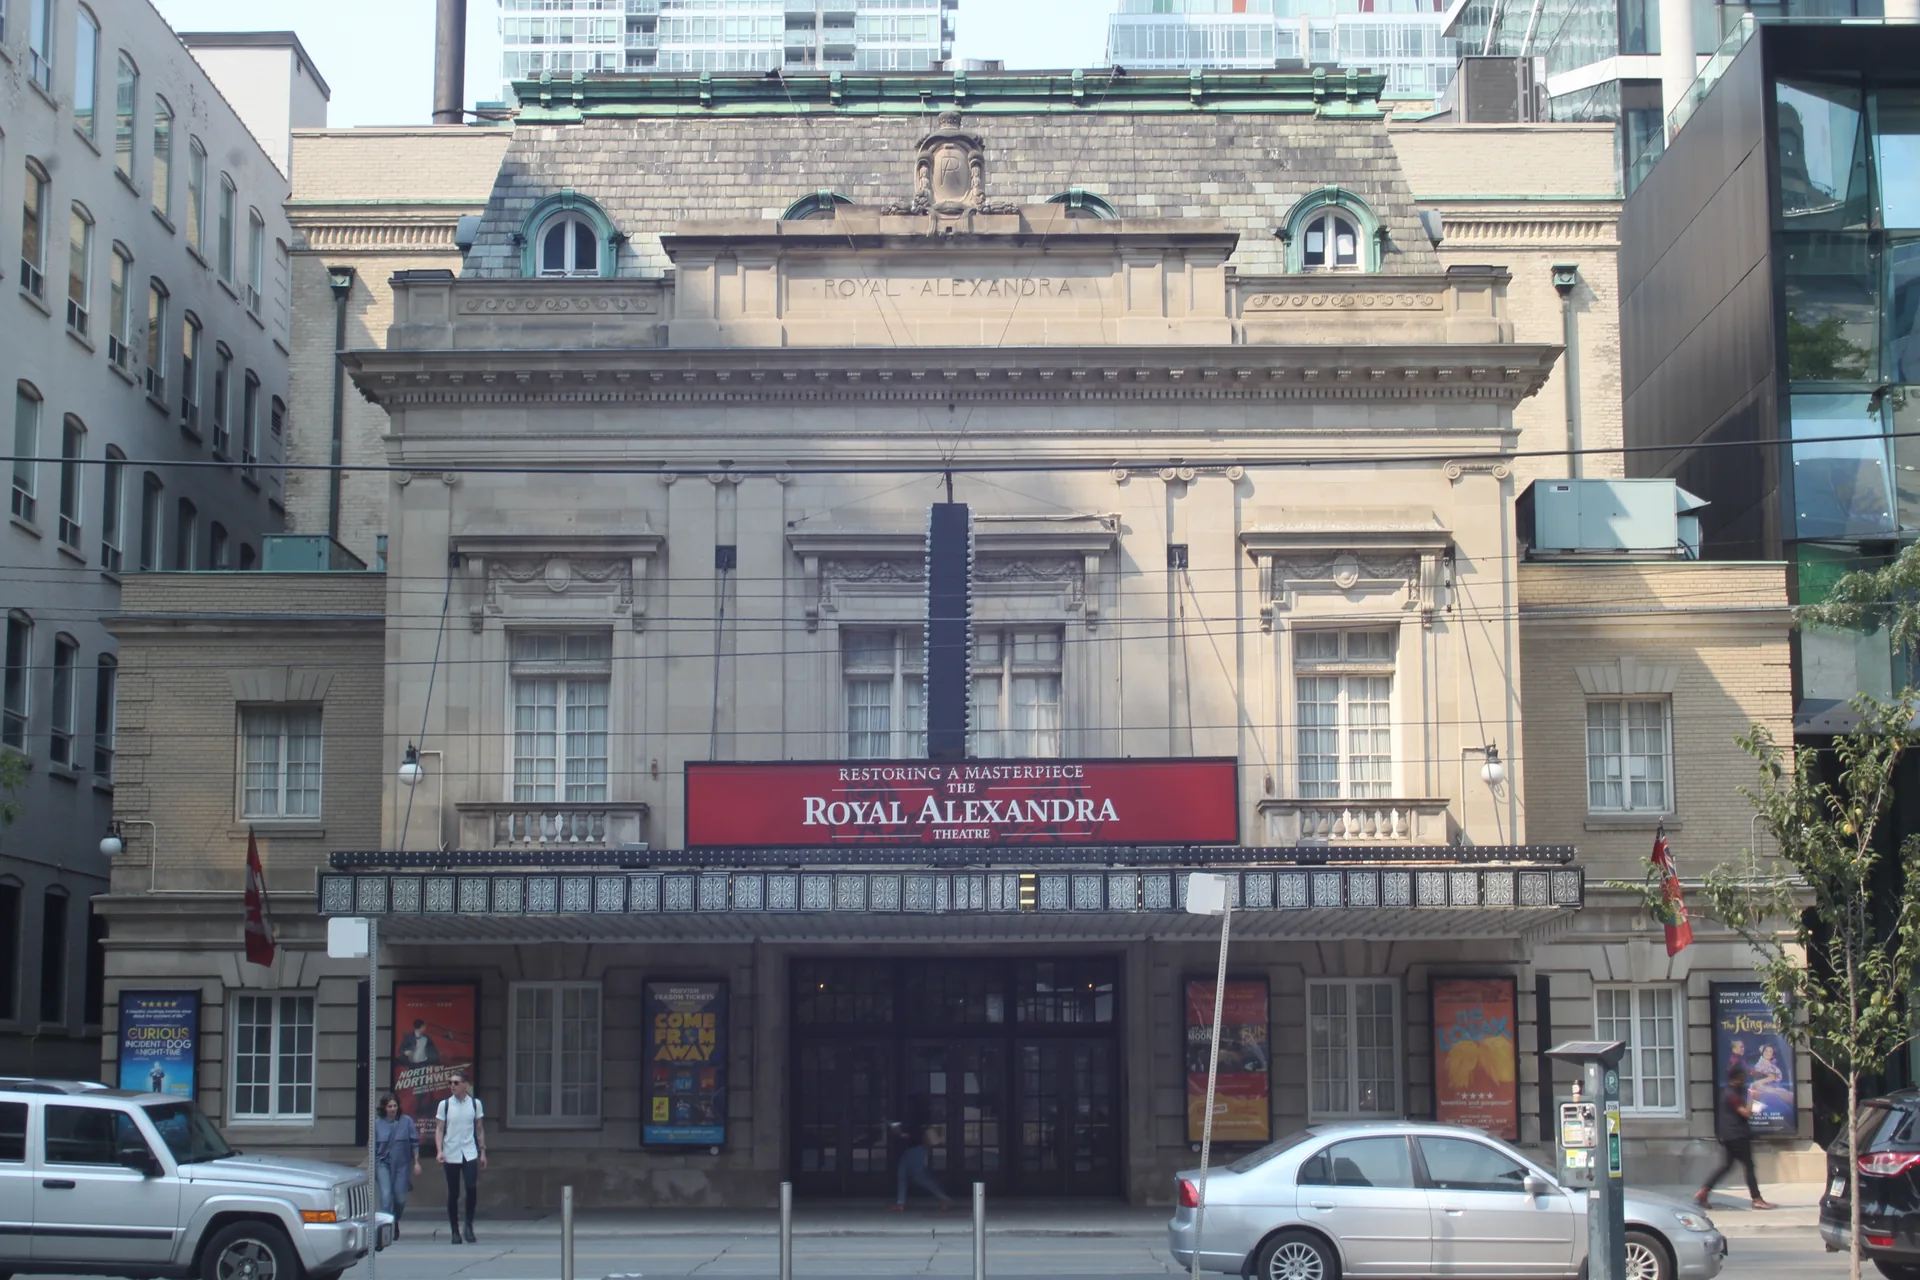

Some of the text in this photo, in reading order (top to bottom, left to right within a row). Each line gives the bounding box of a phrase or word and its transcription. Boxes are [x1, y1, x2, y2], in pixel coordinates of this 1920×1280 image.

[824, 278, 1073, 298] ROYAL ALEXANDRA
[838, 765, 1084, 781] RESTORING A MASTERPIECE
[947, 783, 976, 794] THE
[802, 795, 1120, 826] ROYAL ALEXANDRA
[932, 828, 991, 840] THEATRE
[654, 1012, 716, 1028] COME
[1454, 1006, 1484, 1024] THE
[1732, 1015, 1764, 1035] King
[127, 1027, 190, 1040] CURIOUS
[1437, 1015, 1513, 1052] LORAX
[125, 1040, 161, 1048] INCIDENT
[166, 1039, 192, 1049] DOG
[654, 1044, 715, 1061] AWAY
[398, 1065, 445, 1080] NORTH BY
